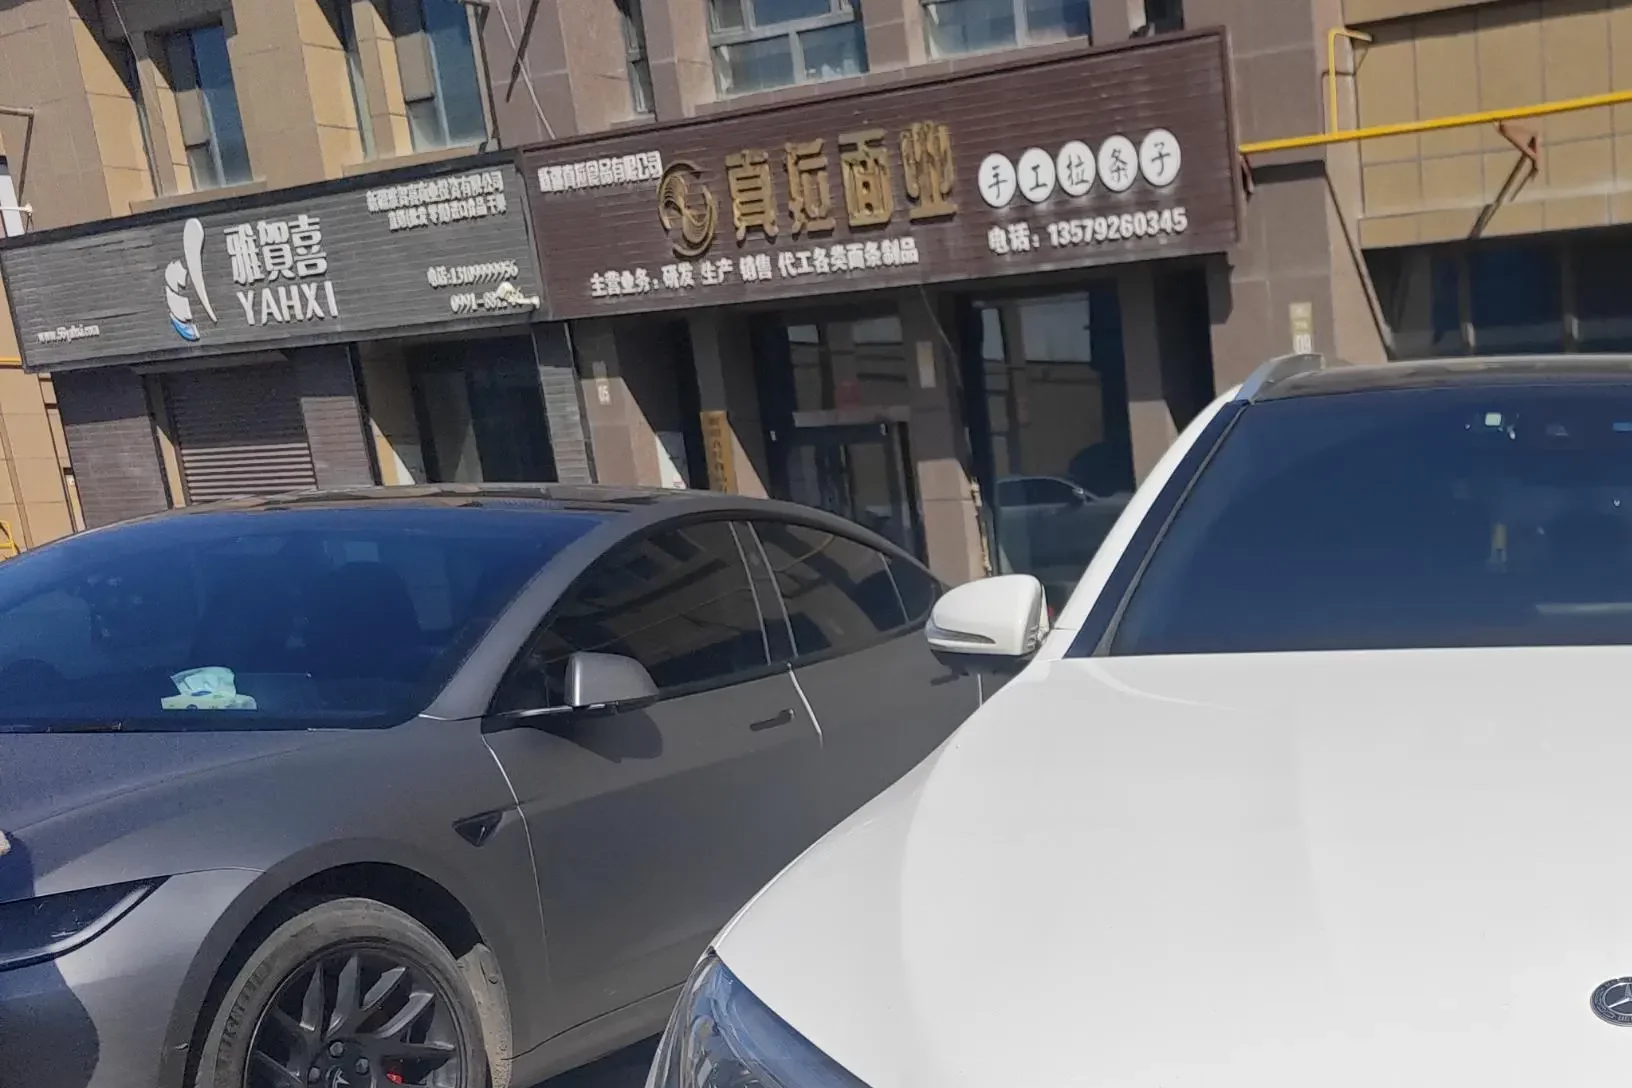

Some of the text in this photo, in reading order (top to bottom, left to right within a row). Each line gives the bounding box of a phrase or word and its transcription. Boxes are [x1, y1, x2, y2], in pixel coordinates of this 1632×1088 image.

[987, 141, 1171, 200] 手工拉条子
[236, 280, 339, 327] YAHXI
